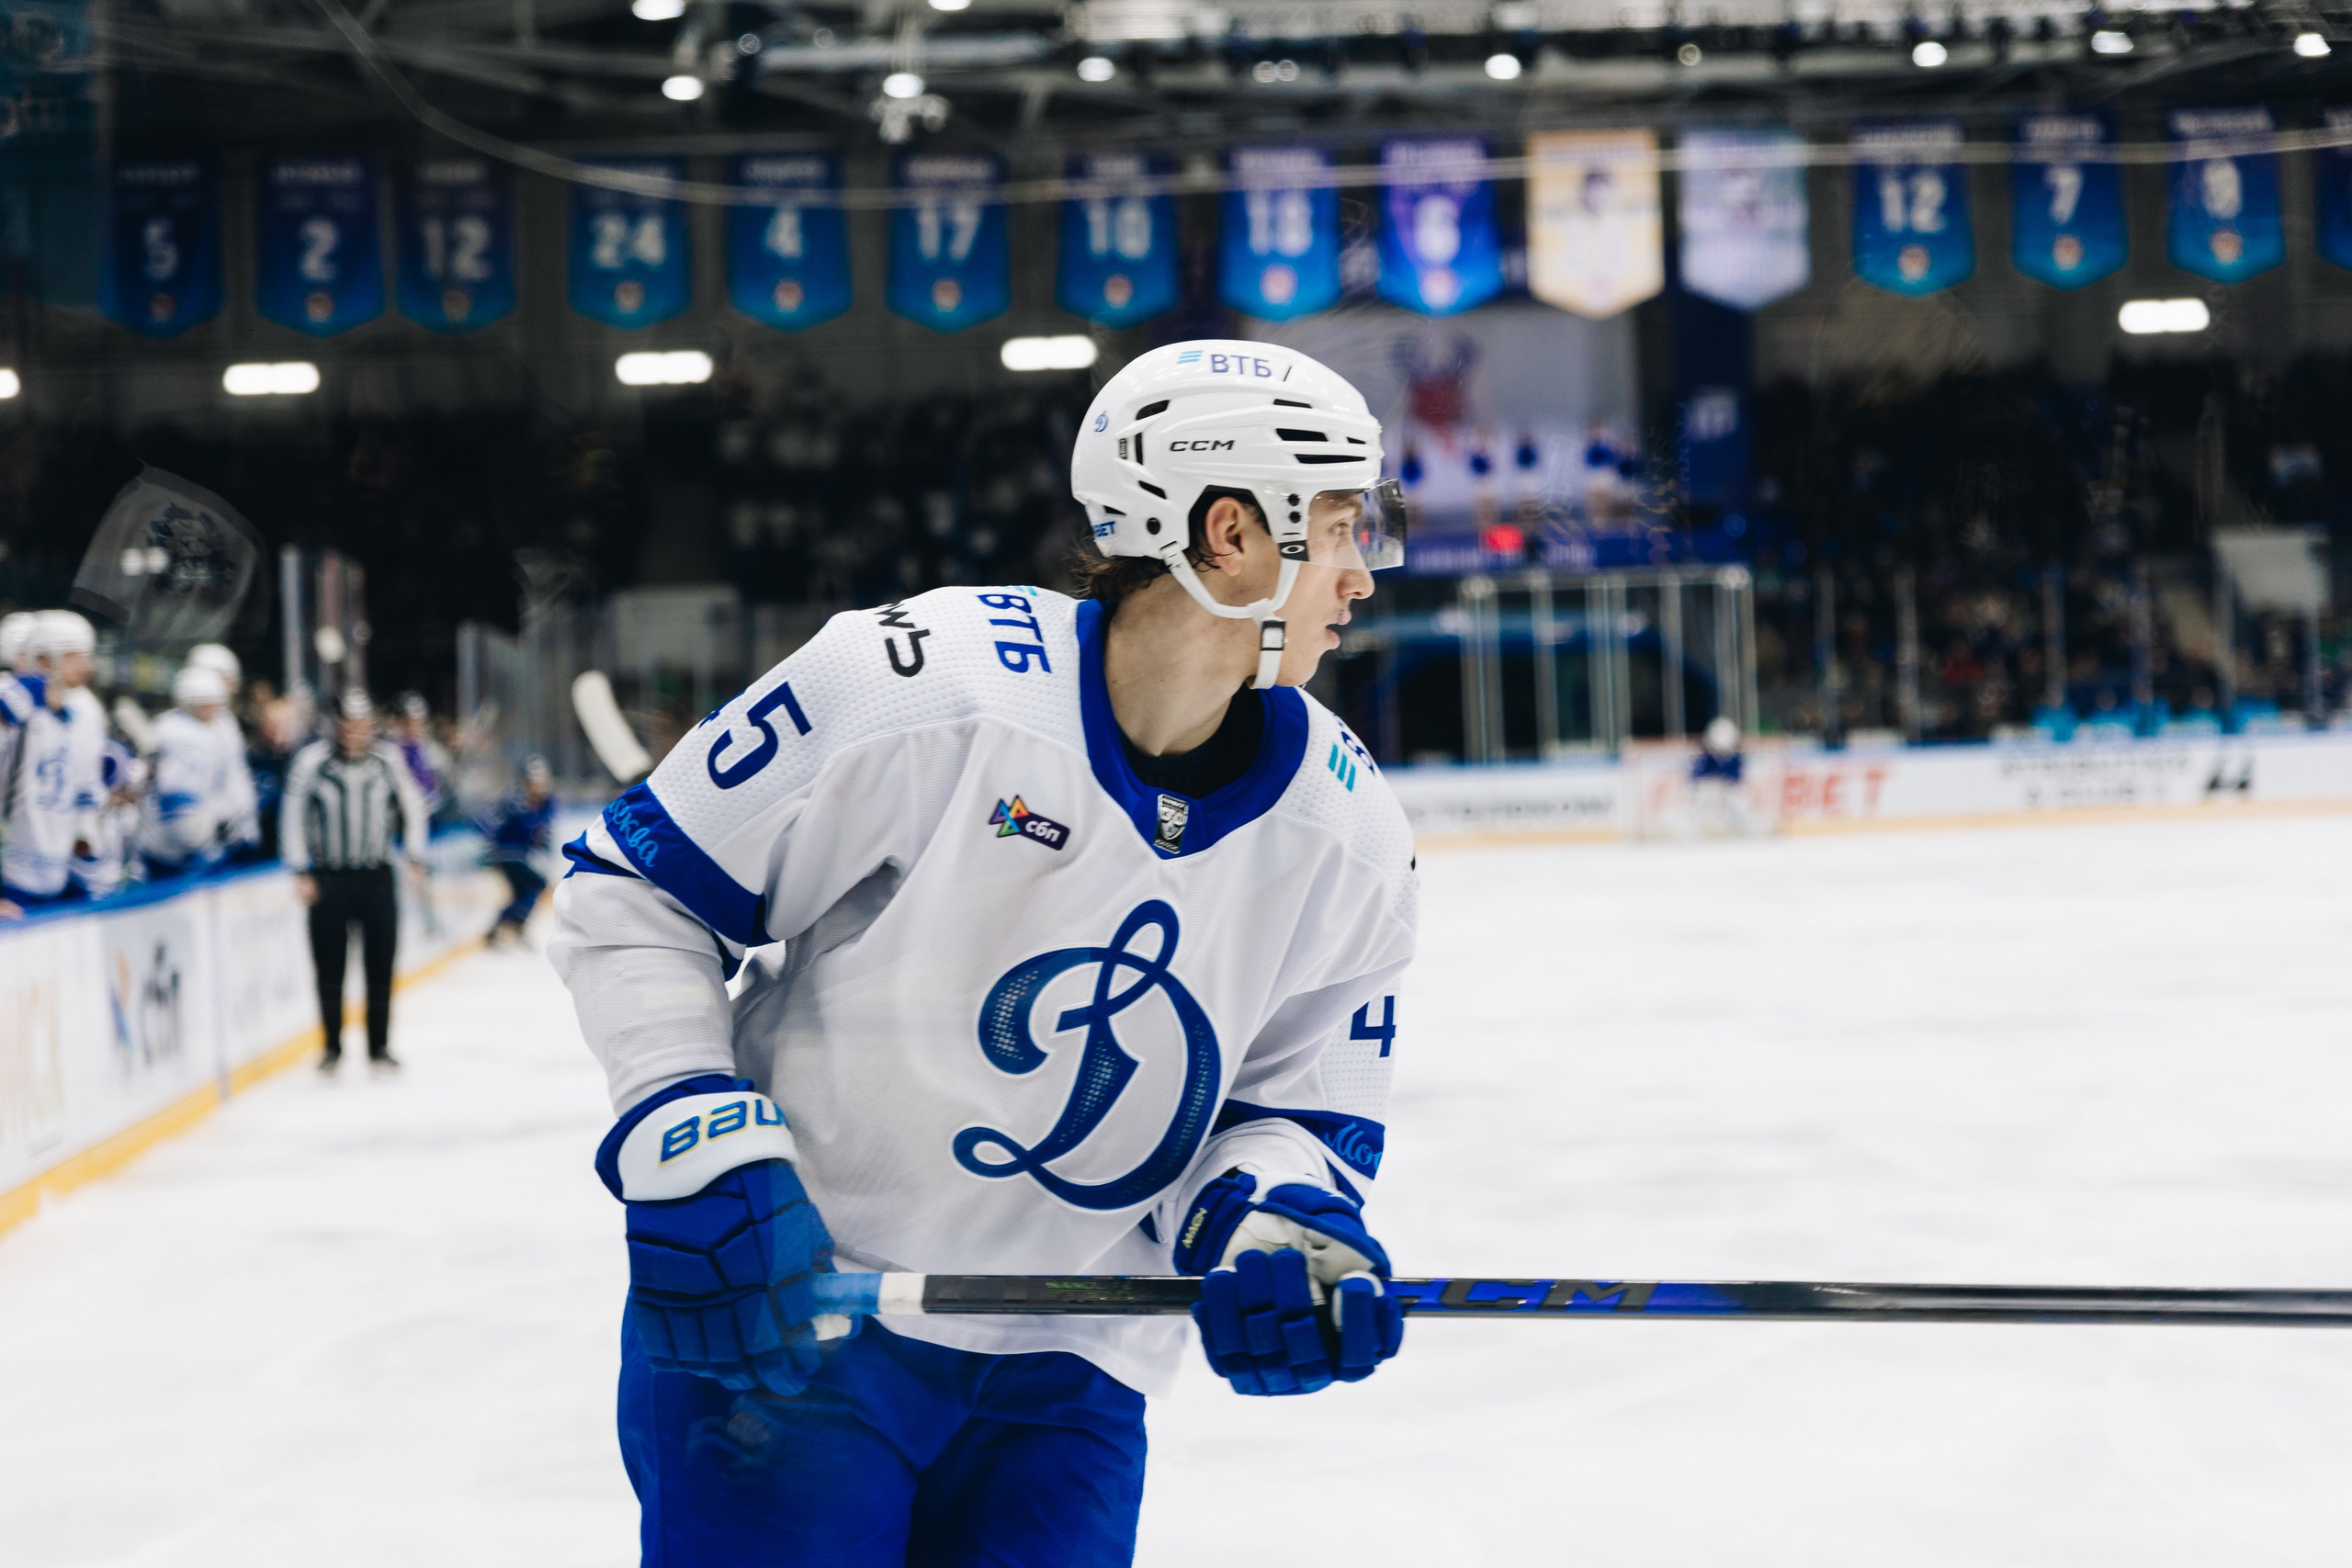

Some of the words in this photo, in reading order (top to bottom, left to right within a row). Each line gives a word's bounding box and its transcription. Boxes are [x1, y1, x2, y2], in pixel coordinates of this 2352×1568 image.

[300, 216, 342, 280] 2
[424, 216, 490, 278] 12
[1211, 354, 1272, 378] ВТБ
[1170, 440, 1235, 451] CCM
[977, 594, 1052, 673] ВТБ
[698, 681, 812, 789] 5
[1025, 820, 1061, 842] сбп
